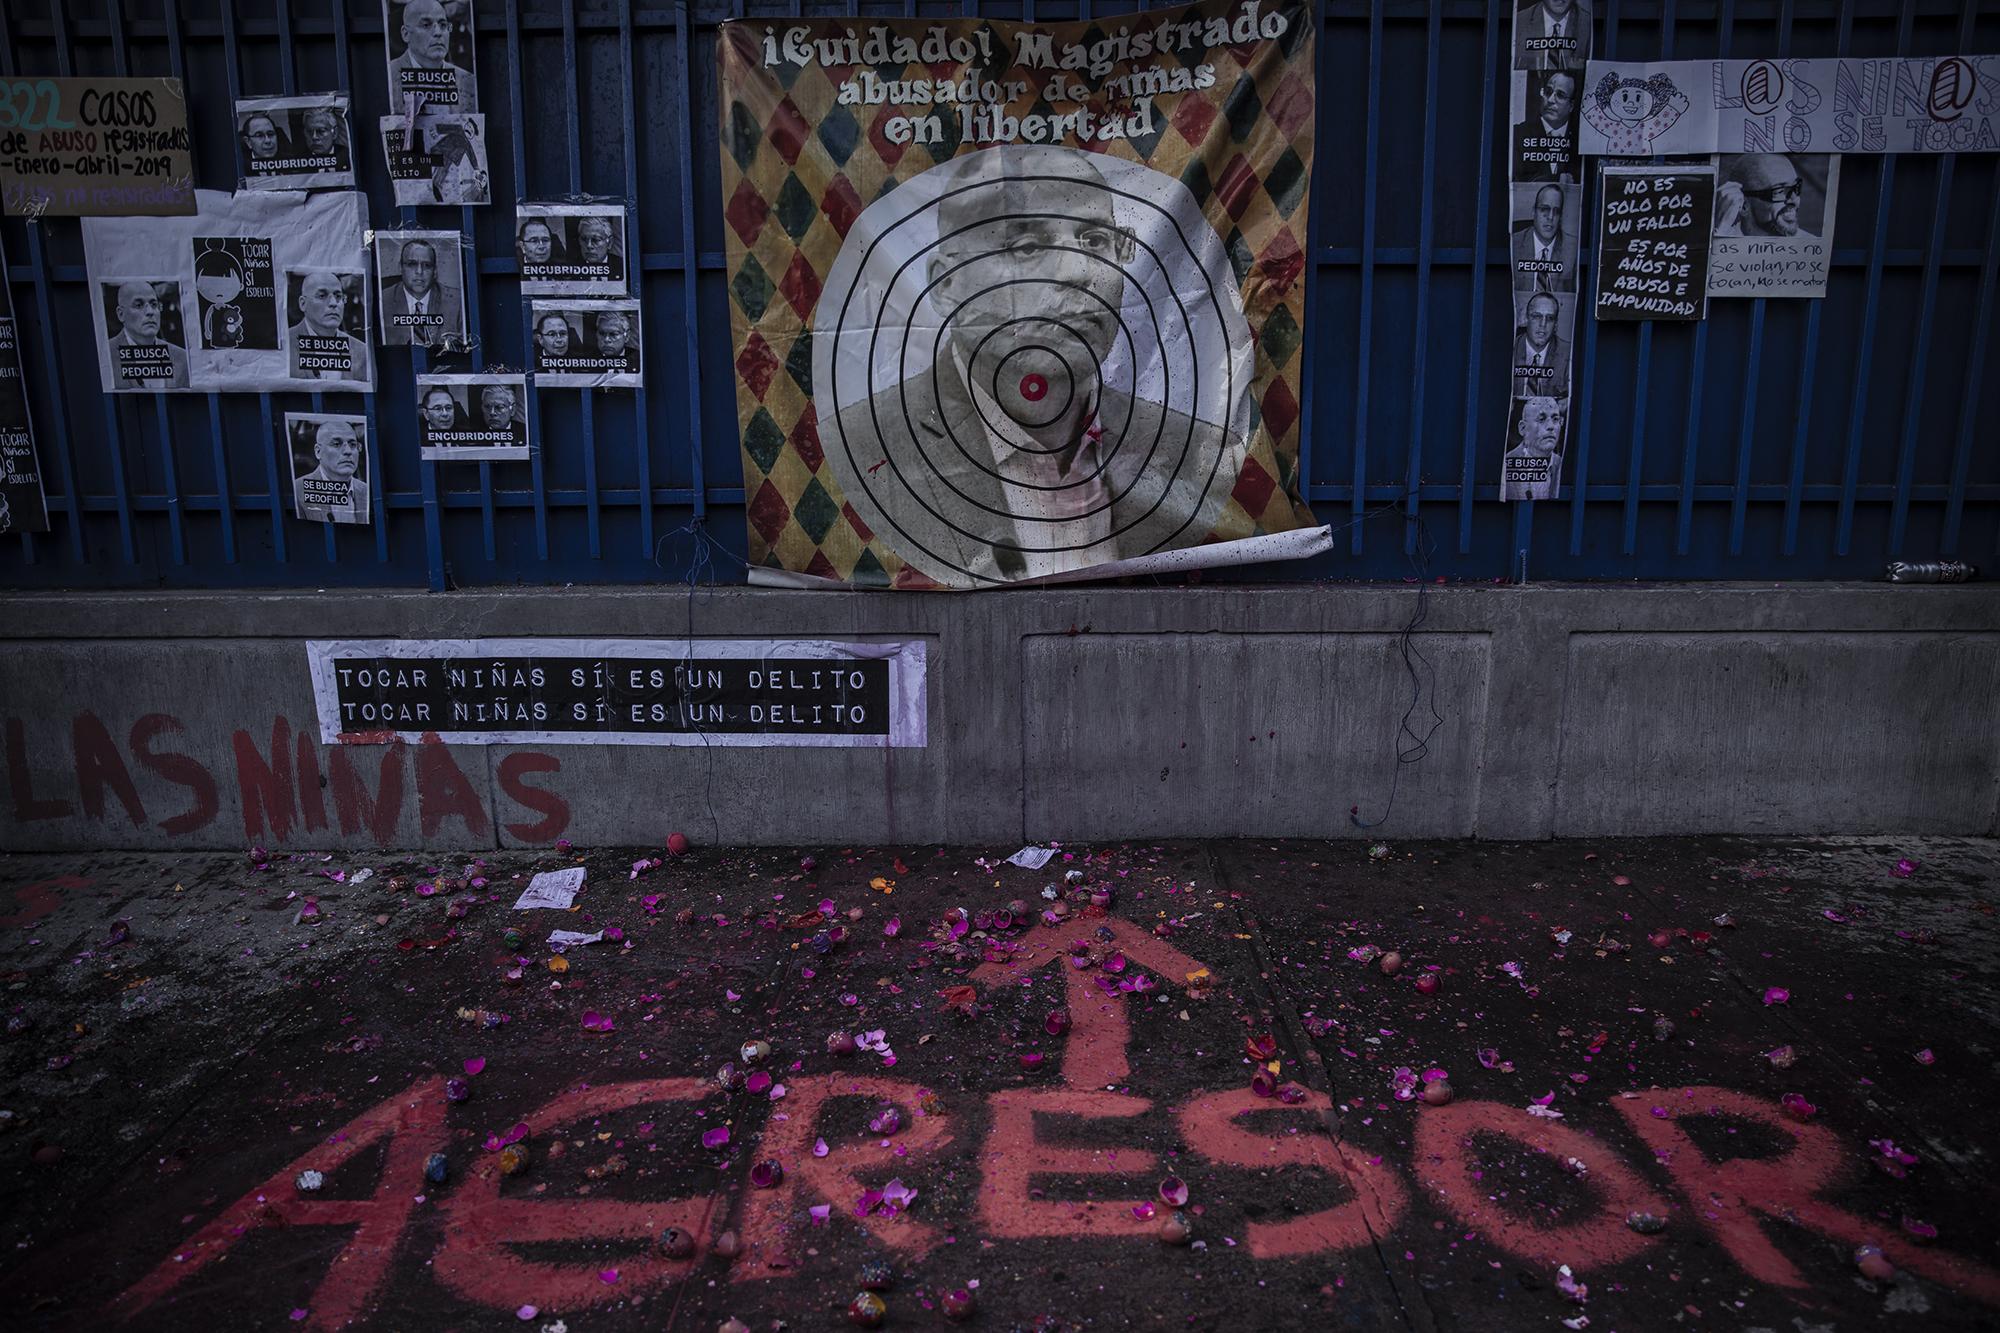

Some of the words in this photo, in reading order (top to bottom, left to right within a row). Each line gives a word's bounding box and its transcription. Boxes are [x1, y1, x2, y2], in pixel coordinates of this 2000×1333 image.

[764, 25, 992, 69] ¡Cuidado!
[1012, 0, 1289, 80] Magistrado
[1526, 38, 1577, 50] PEDOFILO
[401, 71, 415, 83] SE
[417, 71, 457, 84] BUSCA
[838, 68, 1027, 105] abusador
[1041, 74, 1090, 102] de
[1106, 63, 1217, 100] niñas
[1713, 57, 1822, 116] L@S
[885, 114, 945, 145] en
[956, 95, 1156, 144] libertad
[1743, 115, 1812, 153] NO
[1833, 111, 1887, 151] SE
[1, 131, 28, 155] de
[39, 130, 98, 153] ABUSO
[103, 127, 190, 155] registrados
[1523, 138, 1537, 148] SE
[251, 157, 338, 171] ENCUBRIDORES
[1523, 152, 1569, 162] PEDOFILO
[1623, 180, 1649, 196] NO
[1653, 176, 1677, 192] ES
[1606, 197, 1652, 216] SOLO
[1657, 193, 1694, 211] POR
[1608, 218, 1632, 235] UN
[1636, 211, 1692, 232] FALLO
[241, 243, 270, 258] TOCAR
[1627, 239, 1651, 253] ES
[1653, 240, 1688, 260] POR
[1748, 241, 1798, 255] niñas
[1803, 244, 1823, 256] no
[523, 265, 611, 276] ENCUBRIDORES
[1517, 261, 1563, 272] PEDOFILO
[1617, 254, 1667, 275] AÑOS
[1667, 262, 1692, 278] DE
[1613, 274, 1671, 294] ABUSO
[1674, 283, 1689, 296] E
[1598, 291, 1696, 316] IMPUNIDAD
[393, 314, 444, 326] PEDOFILO
[299, 337, 313, 350] SE
[315, 338, 350, 351] BUSCA
[119, 347, 133, 360] SE
[134, 347, 170, 359] BUSCA
[299, 356, 352, 370] PEDOFILO
[541, 357, 628, 369] ENCUBRIDORES
[121, 365, 174, 378] PEDOFILO
[427, 431, 514, 442] ENCUBRIDORES
[1515, 458, 1548, 468] BUSCA
[1506, 471, 1547, 481] EDOFILO
[303, 480, 314, 490] SE
[315, 480, 349, 492] BUSCA
[304, 493, 348, 505] PEDOFILO
[338, 668, 429, 688] TOCAR
[451, 661, 545, 688] NIÑAS
[571, 662, 605, 688] SÍ
[630, 669, 665, 689] ES
[687, 670, 723, 689] UN
[749, 669, 866, 690] DELITO
[343, 702, 431, 721] TOCAR
[454, 696, 548, 723] NIÑAS
[573, 697, 606, 723] SÍ
[631, 703, 666, 723] ES
[689, 703, 724, 723] UN
[750, 703, 866, 723] DELITO
[6, 710, 219, 837] LAS
